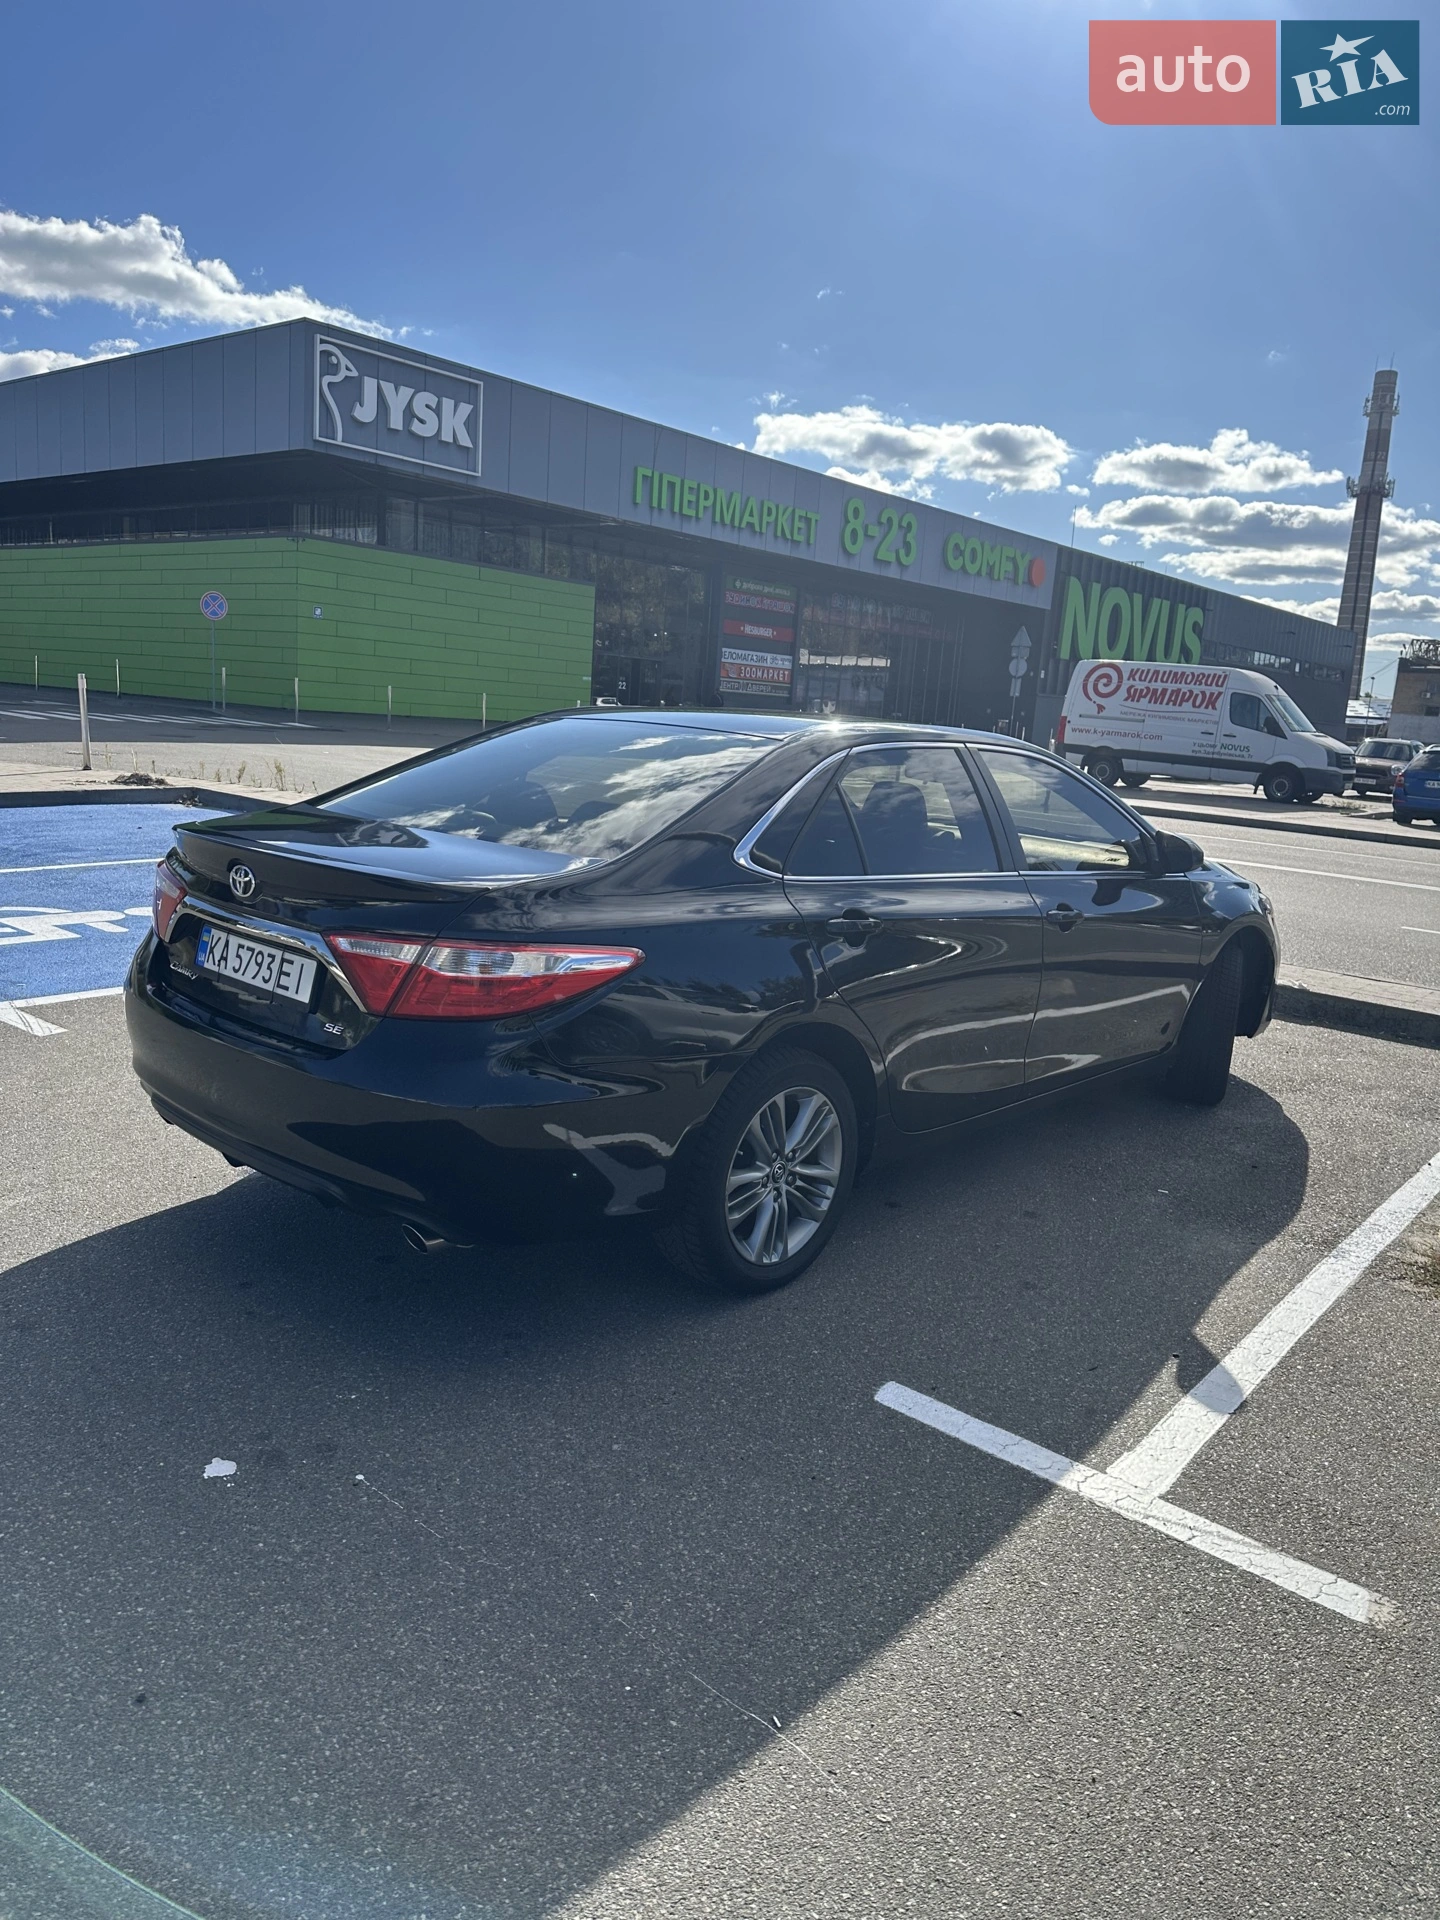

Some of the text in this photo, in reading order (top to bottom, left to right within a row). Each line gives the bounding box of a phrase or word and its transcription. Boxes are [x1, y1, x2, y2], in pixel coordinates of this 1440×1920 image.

[350, 375, 475, 449] JYSK
[632, 465, 821, 546] ГІПЕРМАРКЕТ
[841, 497, 919, 567] 8-23
[943, 531, 1032, 587] COMFY
[744, 623, 773, 638] HESBURGER
[1058, 575, 1204, 665] NOVUS
[722, 650, 769, 665] ЕЛОМАГАЗИН
[740, 666, 789, 681] ЗООМАРКЕТ
[1123, 684, 1224, 711] ЯРМАРОК
[1071, 726, 1163, 742] www.k-yarmarok.com
[1219, 743, 1251, 753] NOVUS
[323, 1022, 345, 1036] SE
